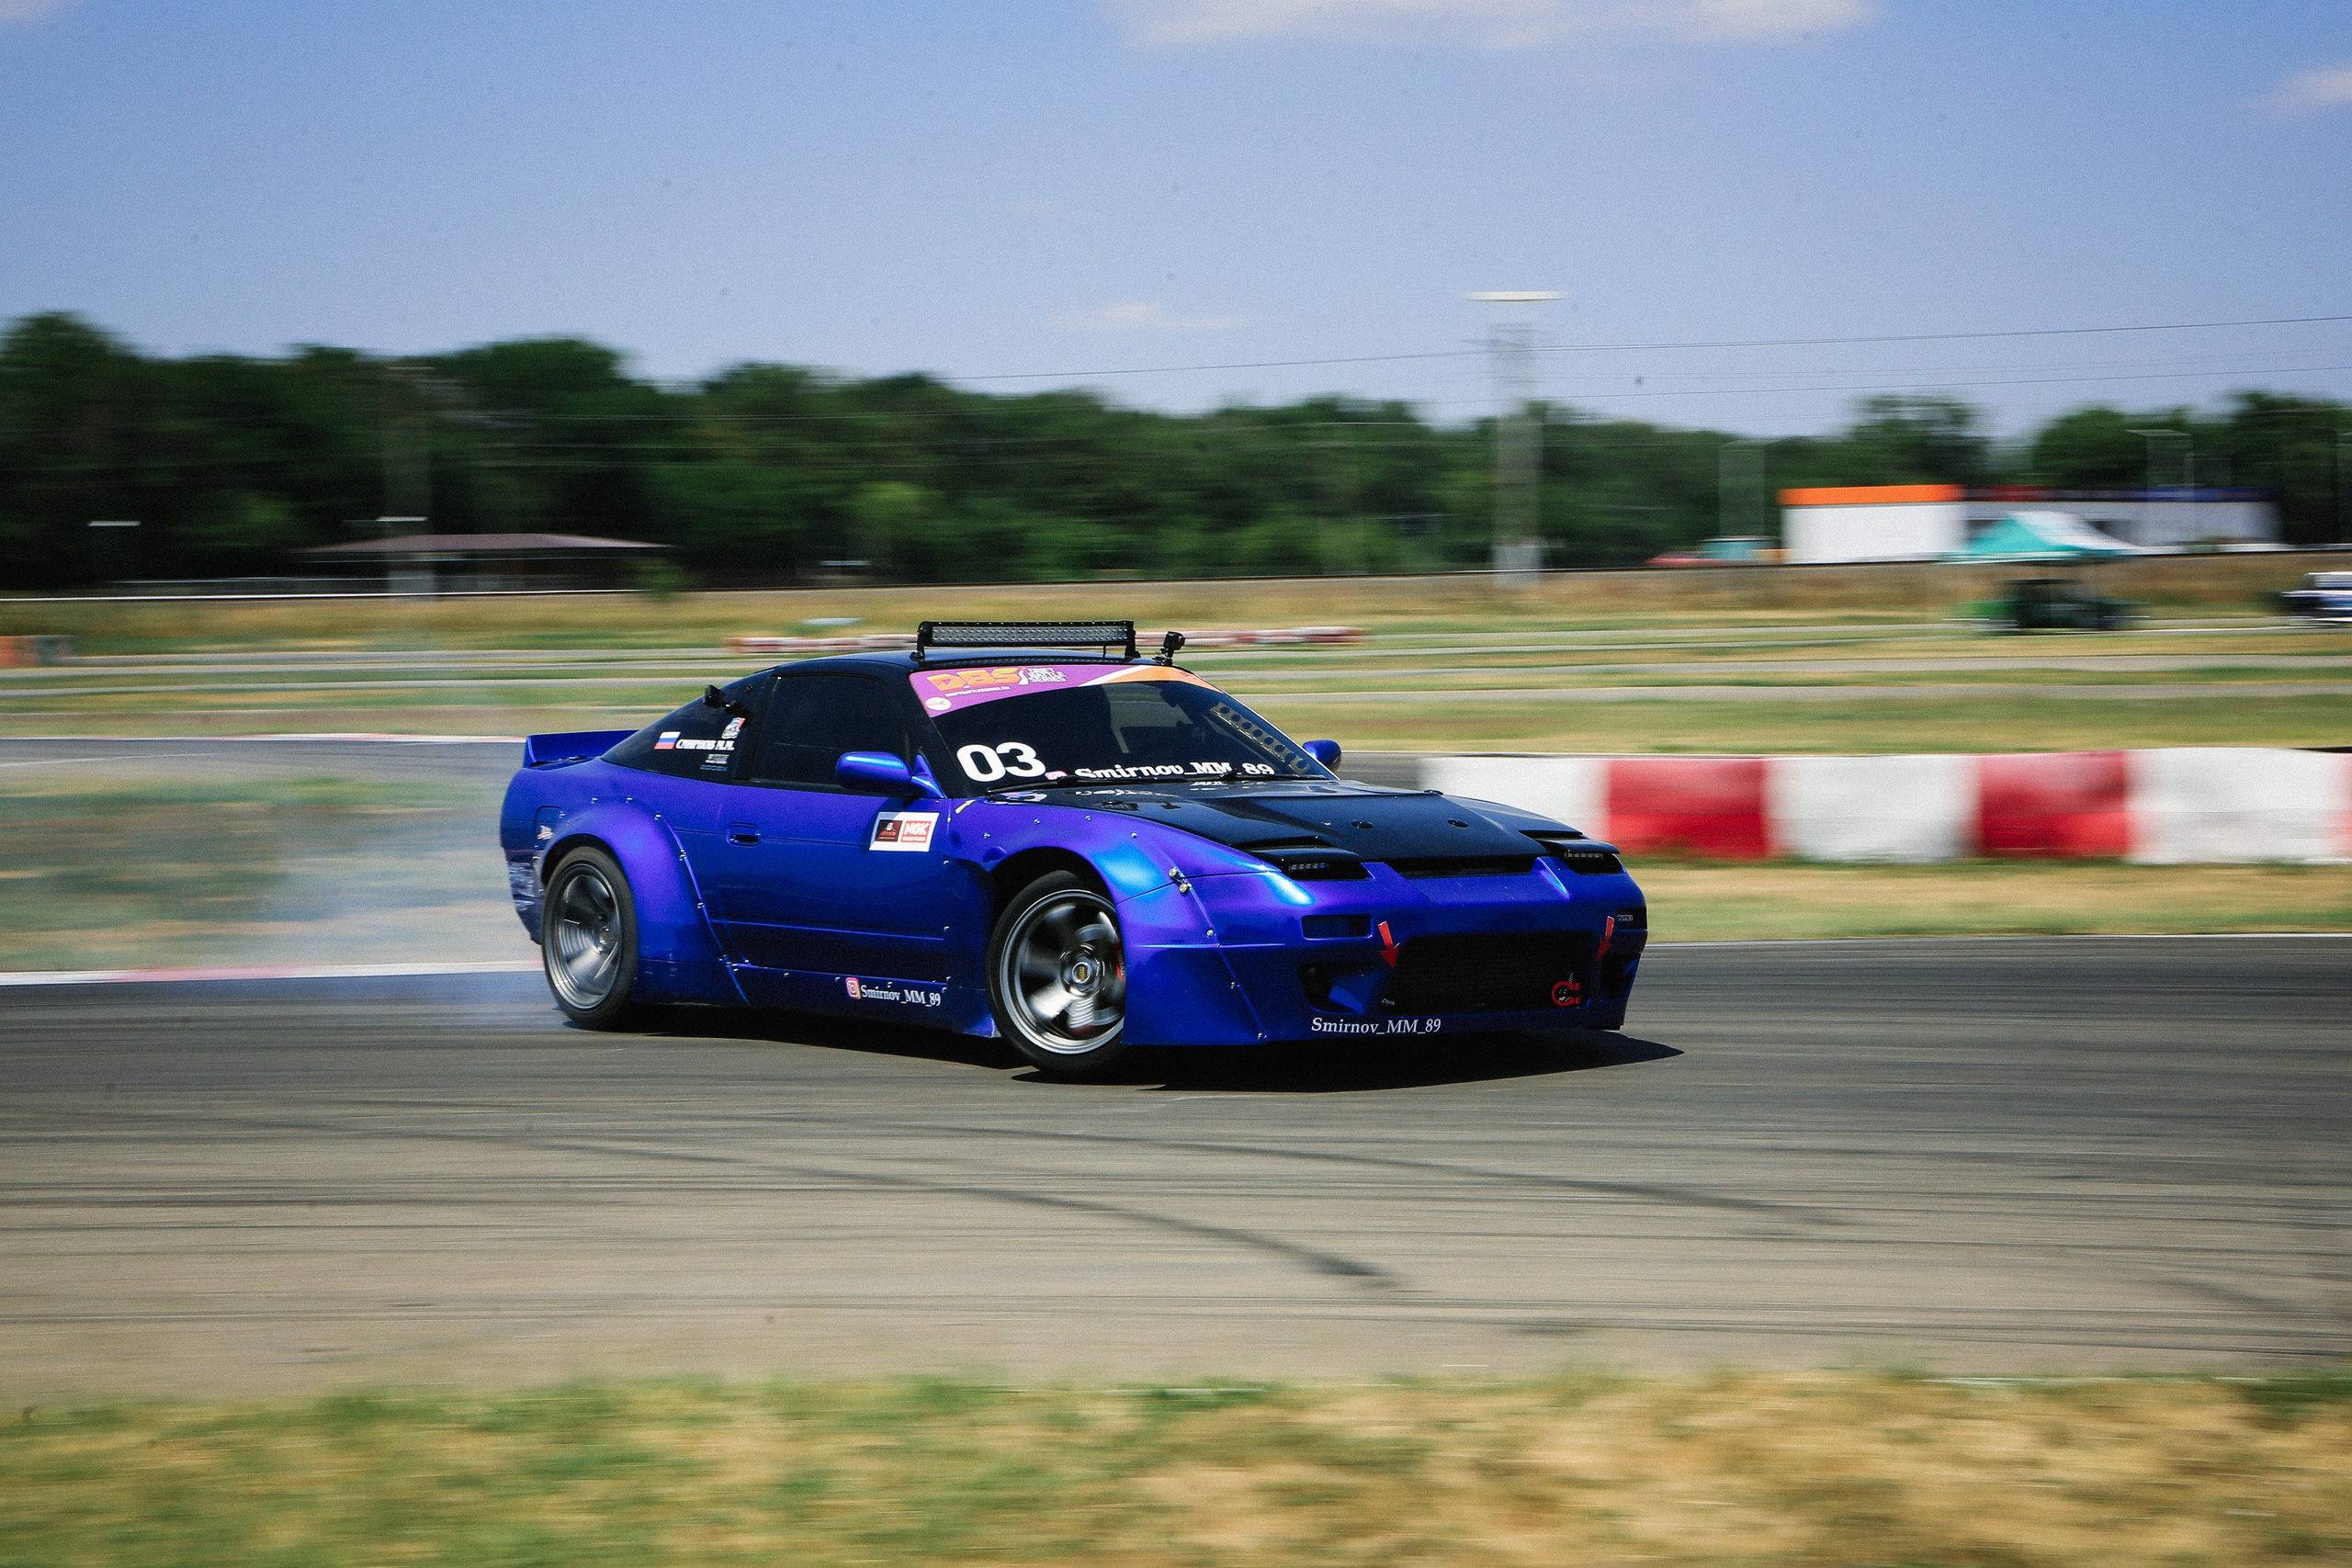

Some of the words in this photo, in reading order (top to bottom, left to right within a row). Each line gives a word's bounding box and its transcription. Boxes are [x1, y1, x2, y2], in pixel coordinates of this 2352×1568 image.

[926, 668, 1021, 692] DBS
[956, 741, 1046, 783] 03
[904, 822, 930, 835] NGK
[860, 985, 942, 1007] Smirnov_MM_89
[1310, 1017, 1442, 1035] Smirnov_MM_89
